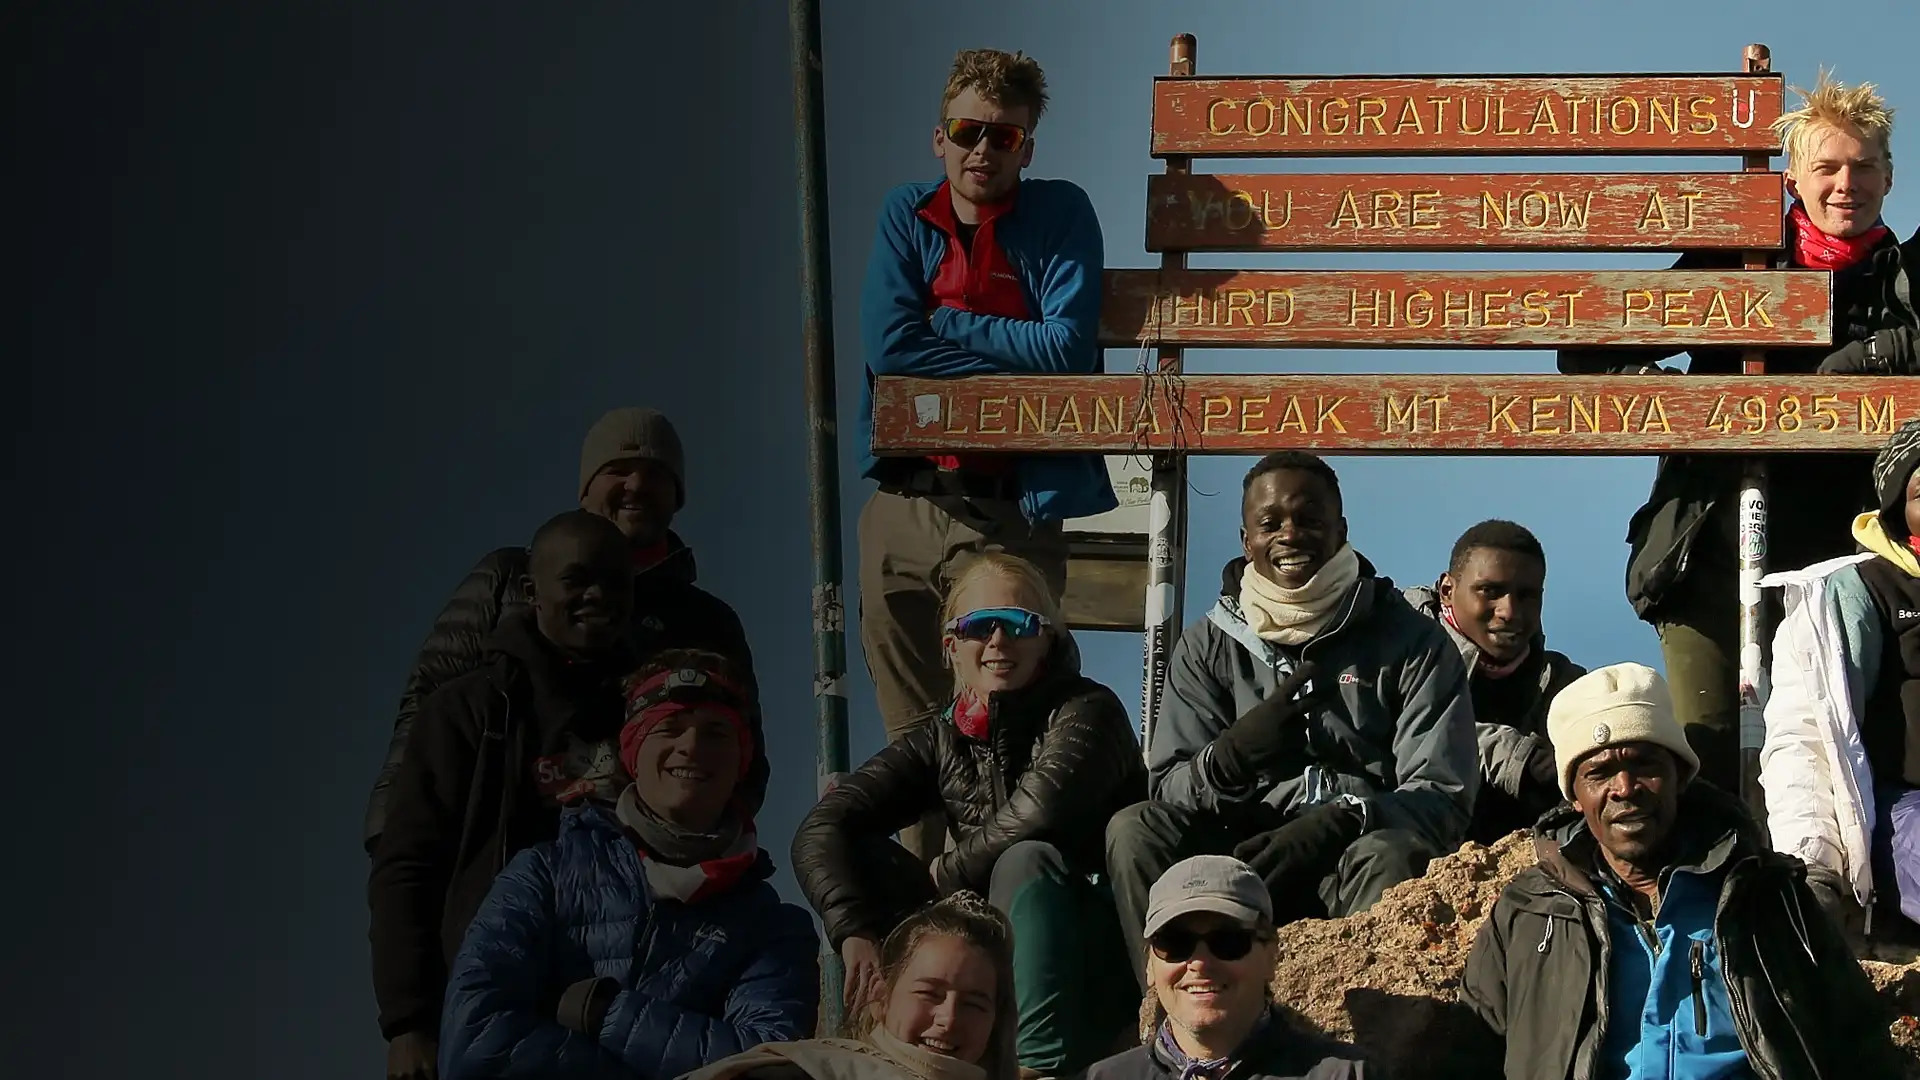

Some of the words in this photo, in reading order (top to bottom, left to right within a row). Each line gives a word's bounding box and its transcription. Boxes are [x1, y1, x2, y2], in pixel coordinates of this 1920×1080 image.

[1205, 96, 1717, 136] CONGRATULATIONS
[1187, 189, 1293, 230] YOU
[1331, 190, 1442, 230] ARE
[1479, 190, 1593, 230] NOW
[1639, 190, 1703, 231] AT
[1347, 289, 1584, 328] HIGHEST
[1622, 289, 1775, 328] PEAK
[943, 394, 1162, 435] LENANA
[1201, 395, 1348, 434] PEAK
[1486, 394, 1672, 435] KENYA
